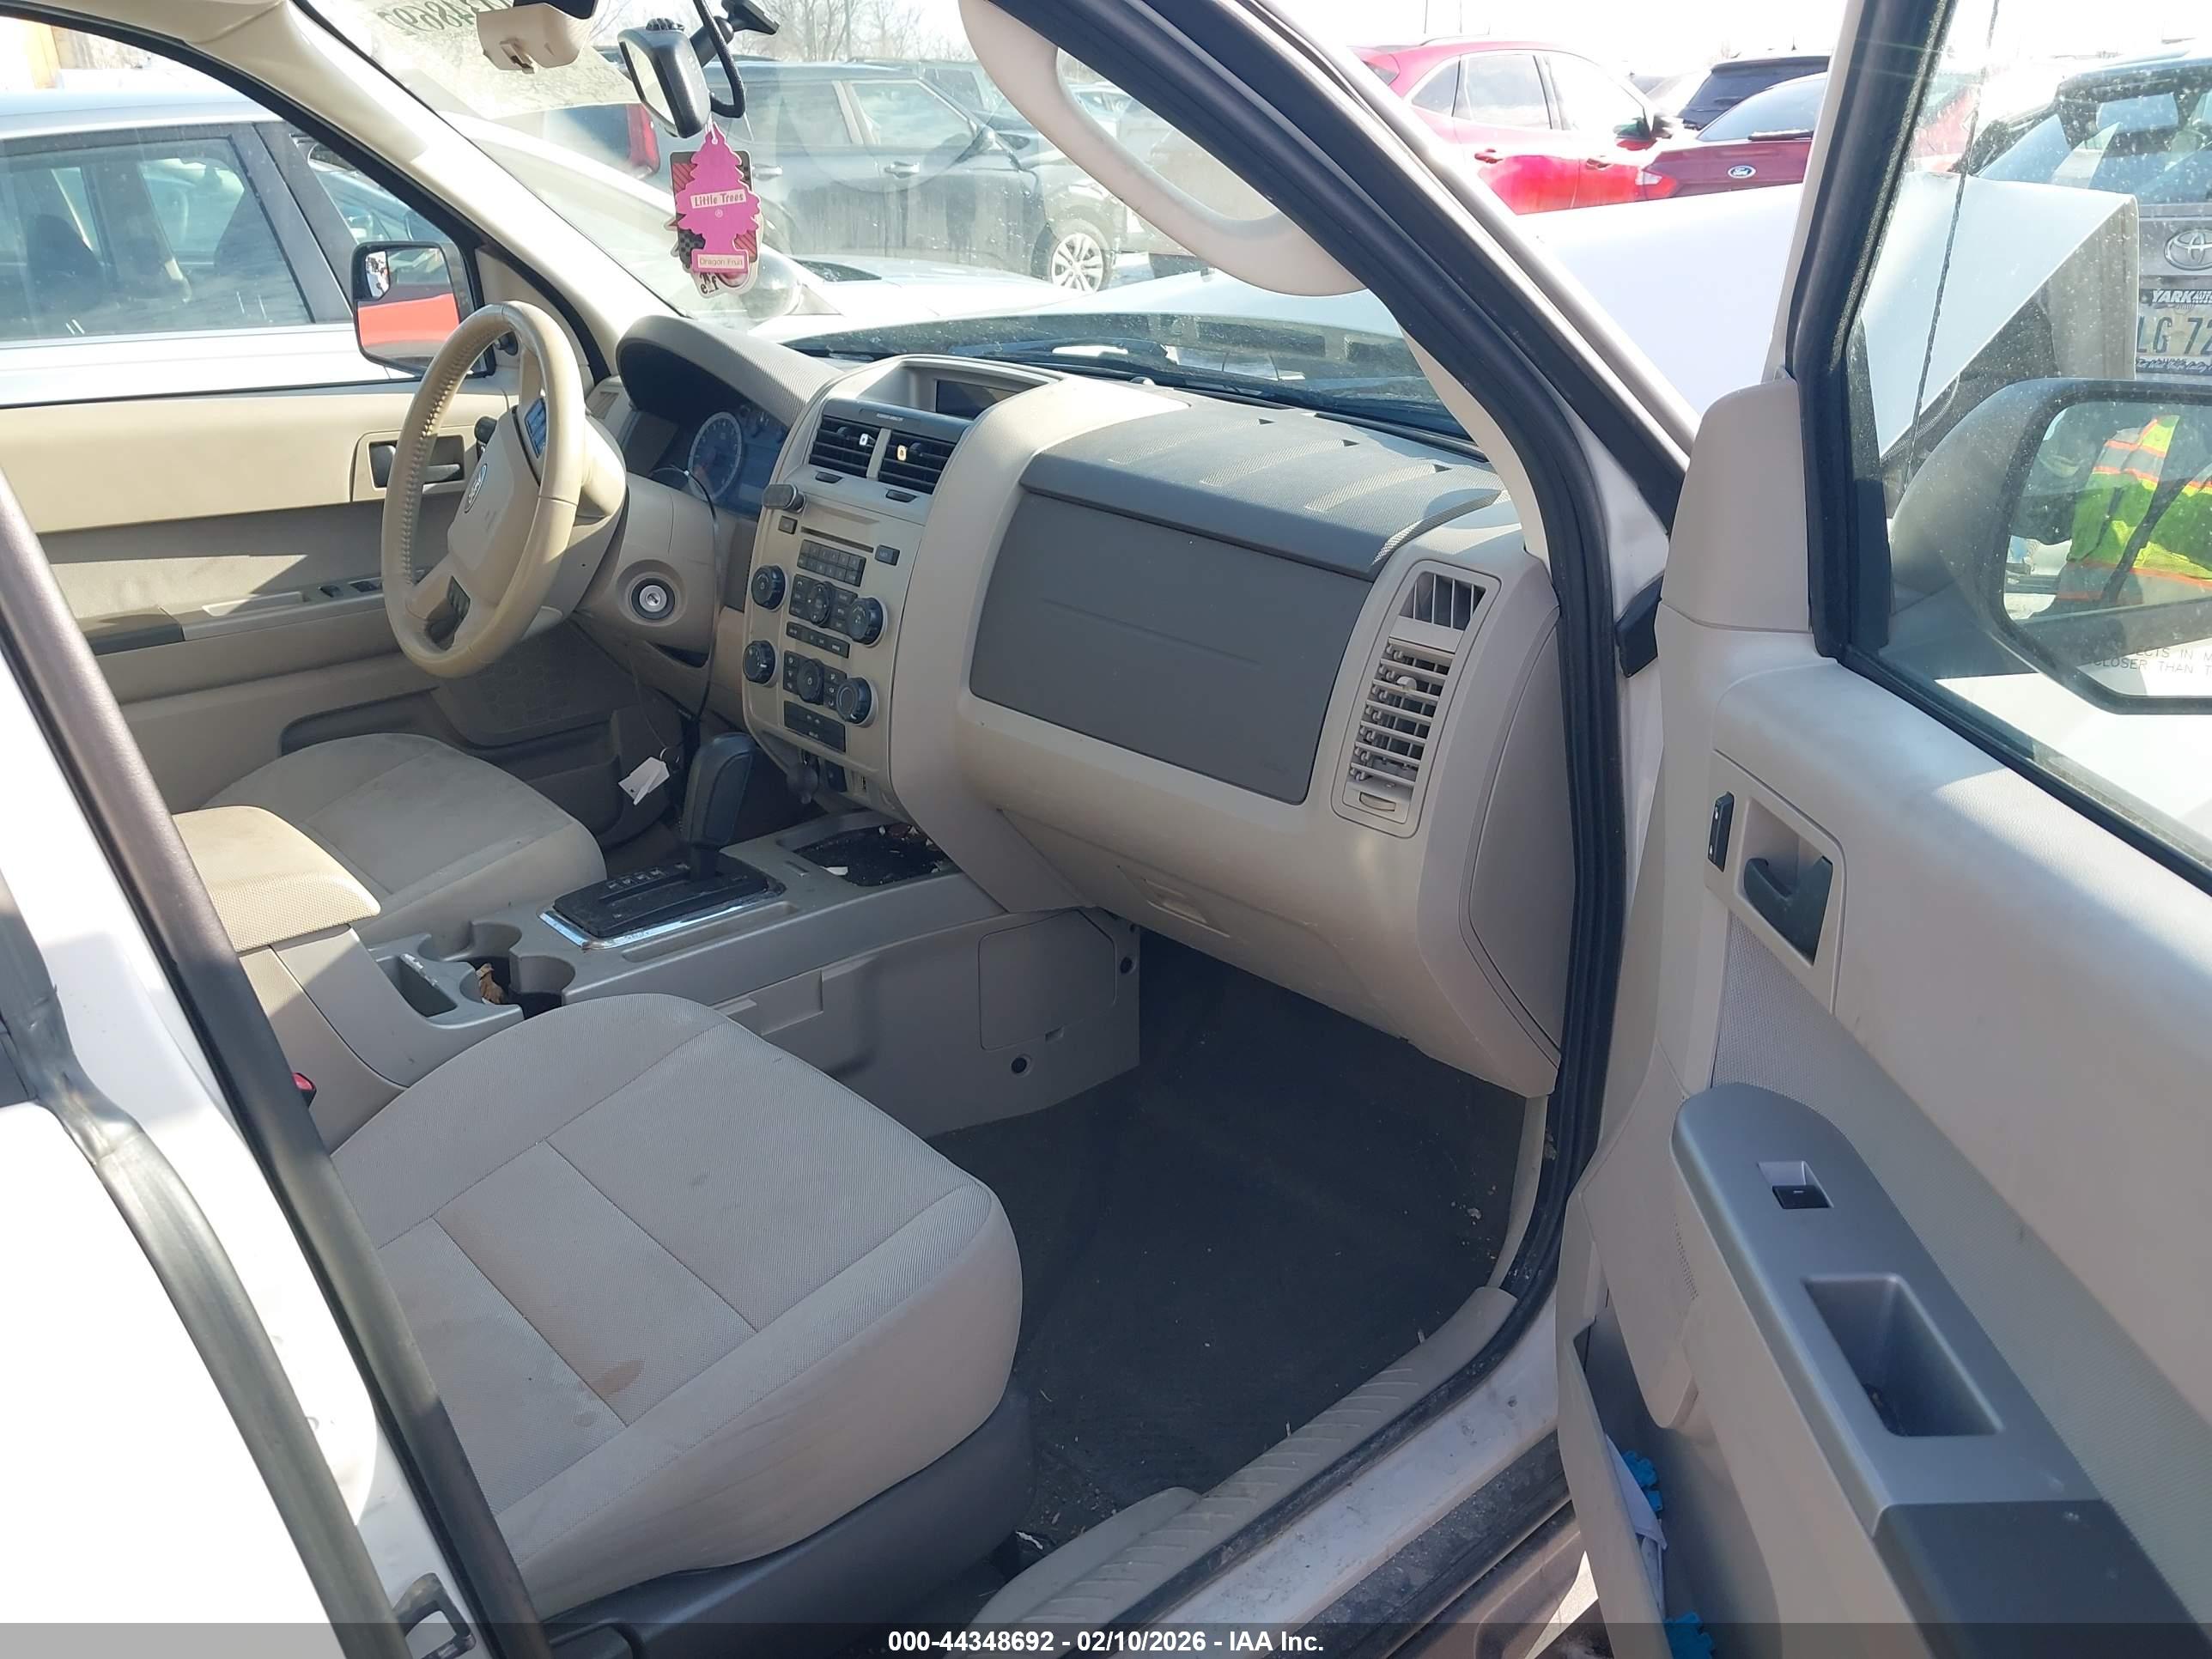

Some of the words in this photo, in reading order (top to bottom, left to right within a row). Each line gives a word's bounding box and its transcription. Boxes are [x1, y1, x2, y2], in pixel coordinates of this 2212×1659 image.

[695, 195, 718, 207] Little
[720, 193, 744, 204] Trees
[700, 258, 726, 268] Dragon
[2152, 289, 2193, 303] YARK
[2192, 290, 2212, 303] AUT
[2185, 318, 2212, 355] 72
[2157, 661, 2194, 674] THAN
